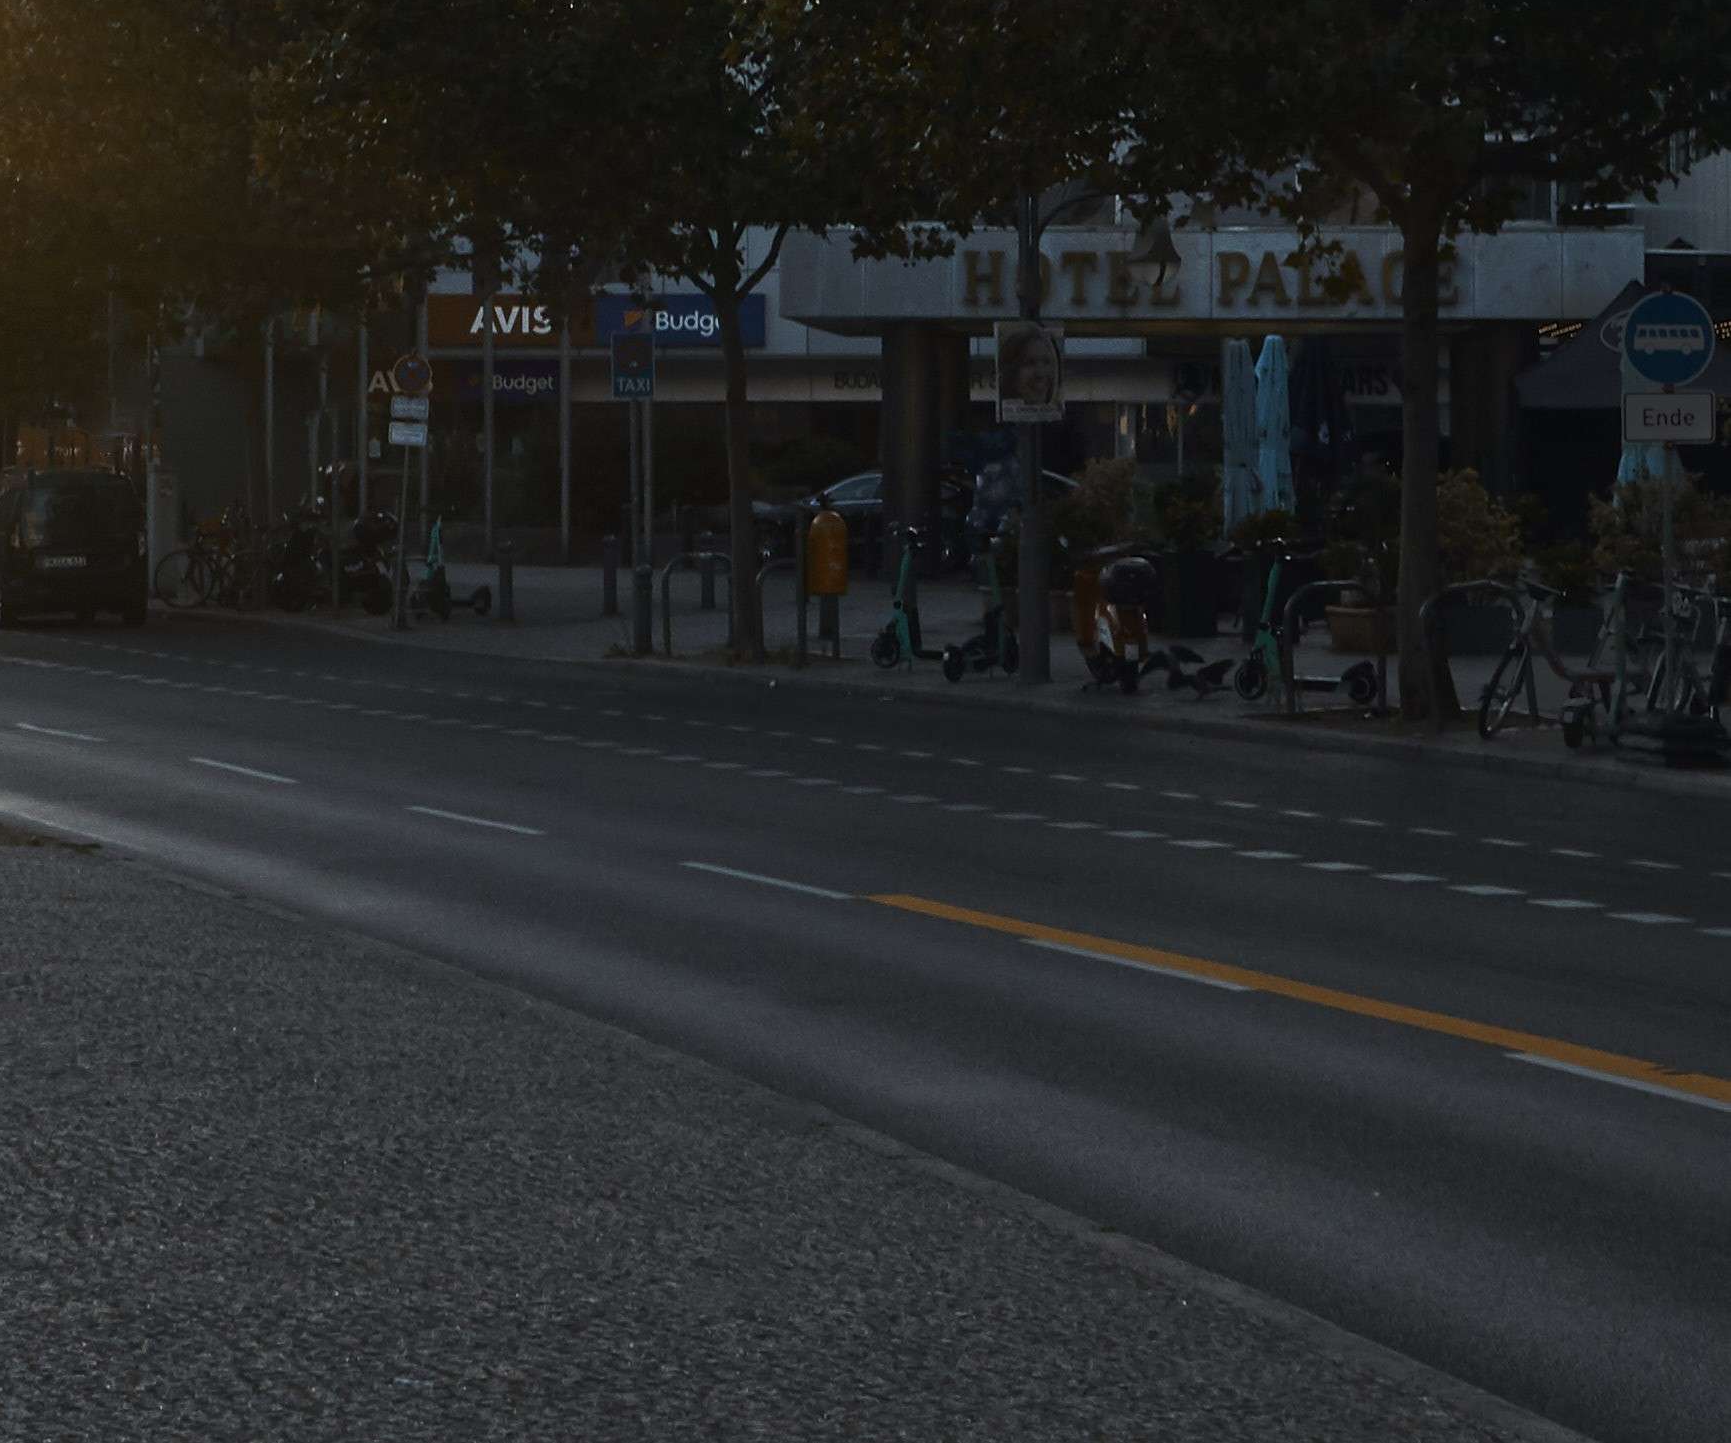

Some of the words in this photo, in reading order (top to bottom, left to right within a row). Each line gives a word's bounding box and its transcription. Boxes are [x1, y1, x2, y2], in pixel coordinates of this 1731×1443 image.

[469, 304, 553, 335] AVIS
[655, 309, 722, 338] Budg
[492, 373, 556, 394] Budget
[616, 377, 652, 393] TAXI
[1643, 409, 1695, 426] Ende
